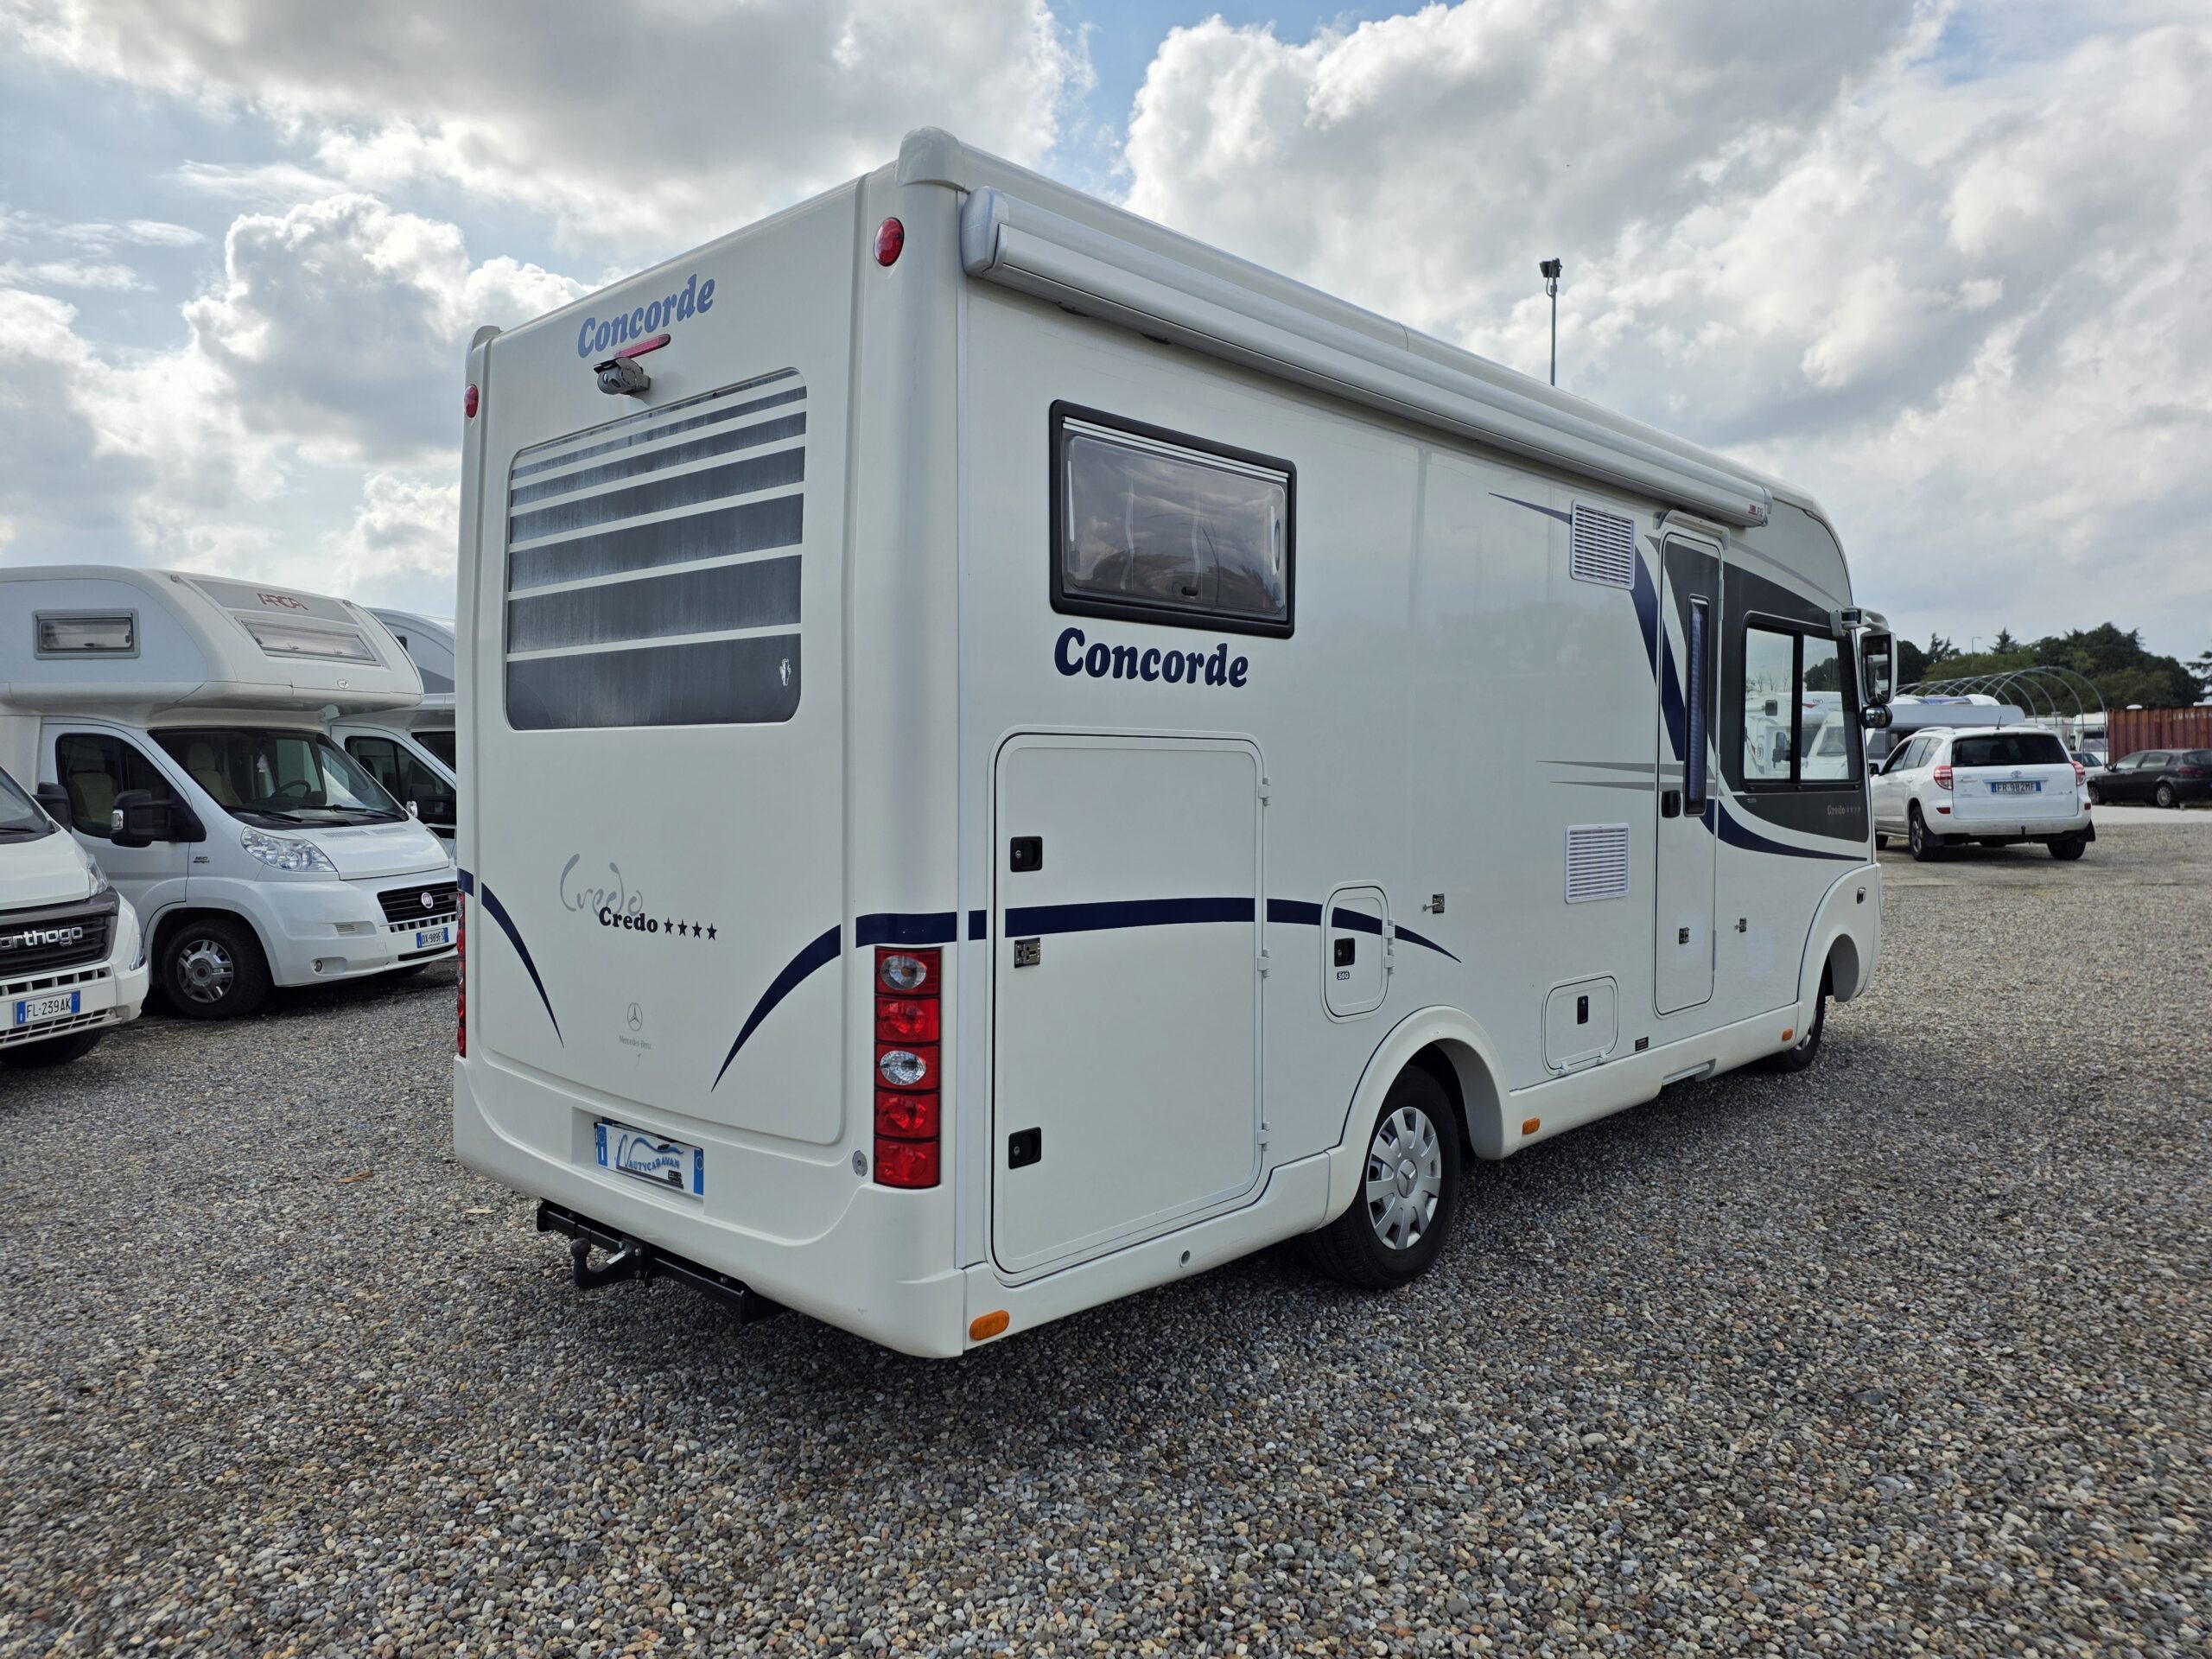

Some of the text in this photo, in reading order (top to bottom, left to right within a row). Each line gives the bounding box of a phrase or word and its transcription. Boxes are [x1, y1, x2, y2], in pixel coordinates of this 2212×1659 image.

[577, 273, 715, 359] Concorde
[1054, 627, 1249, 688] Concorde
[599, 906, 658, 933] Credo
